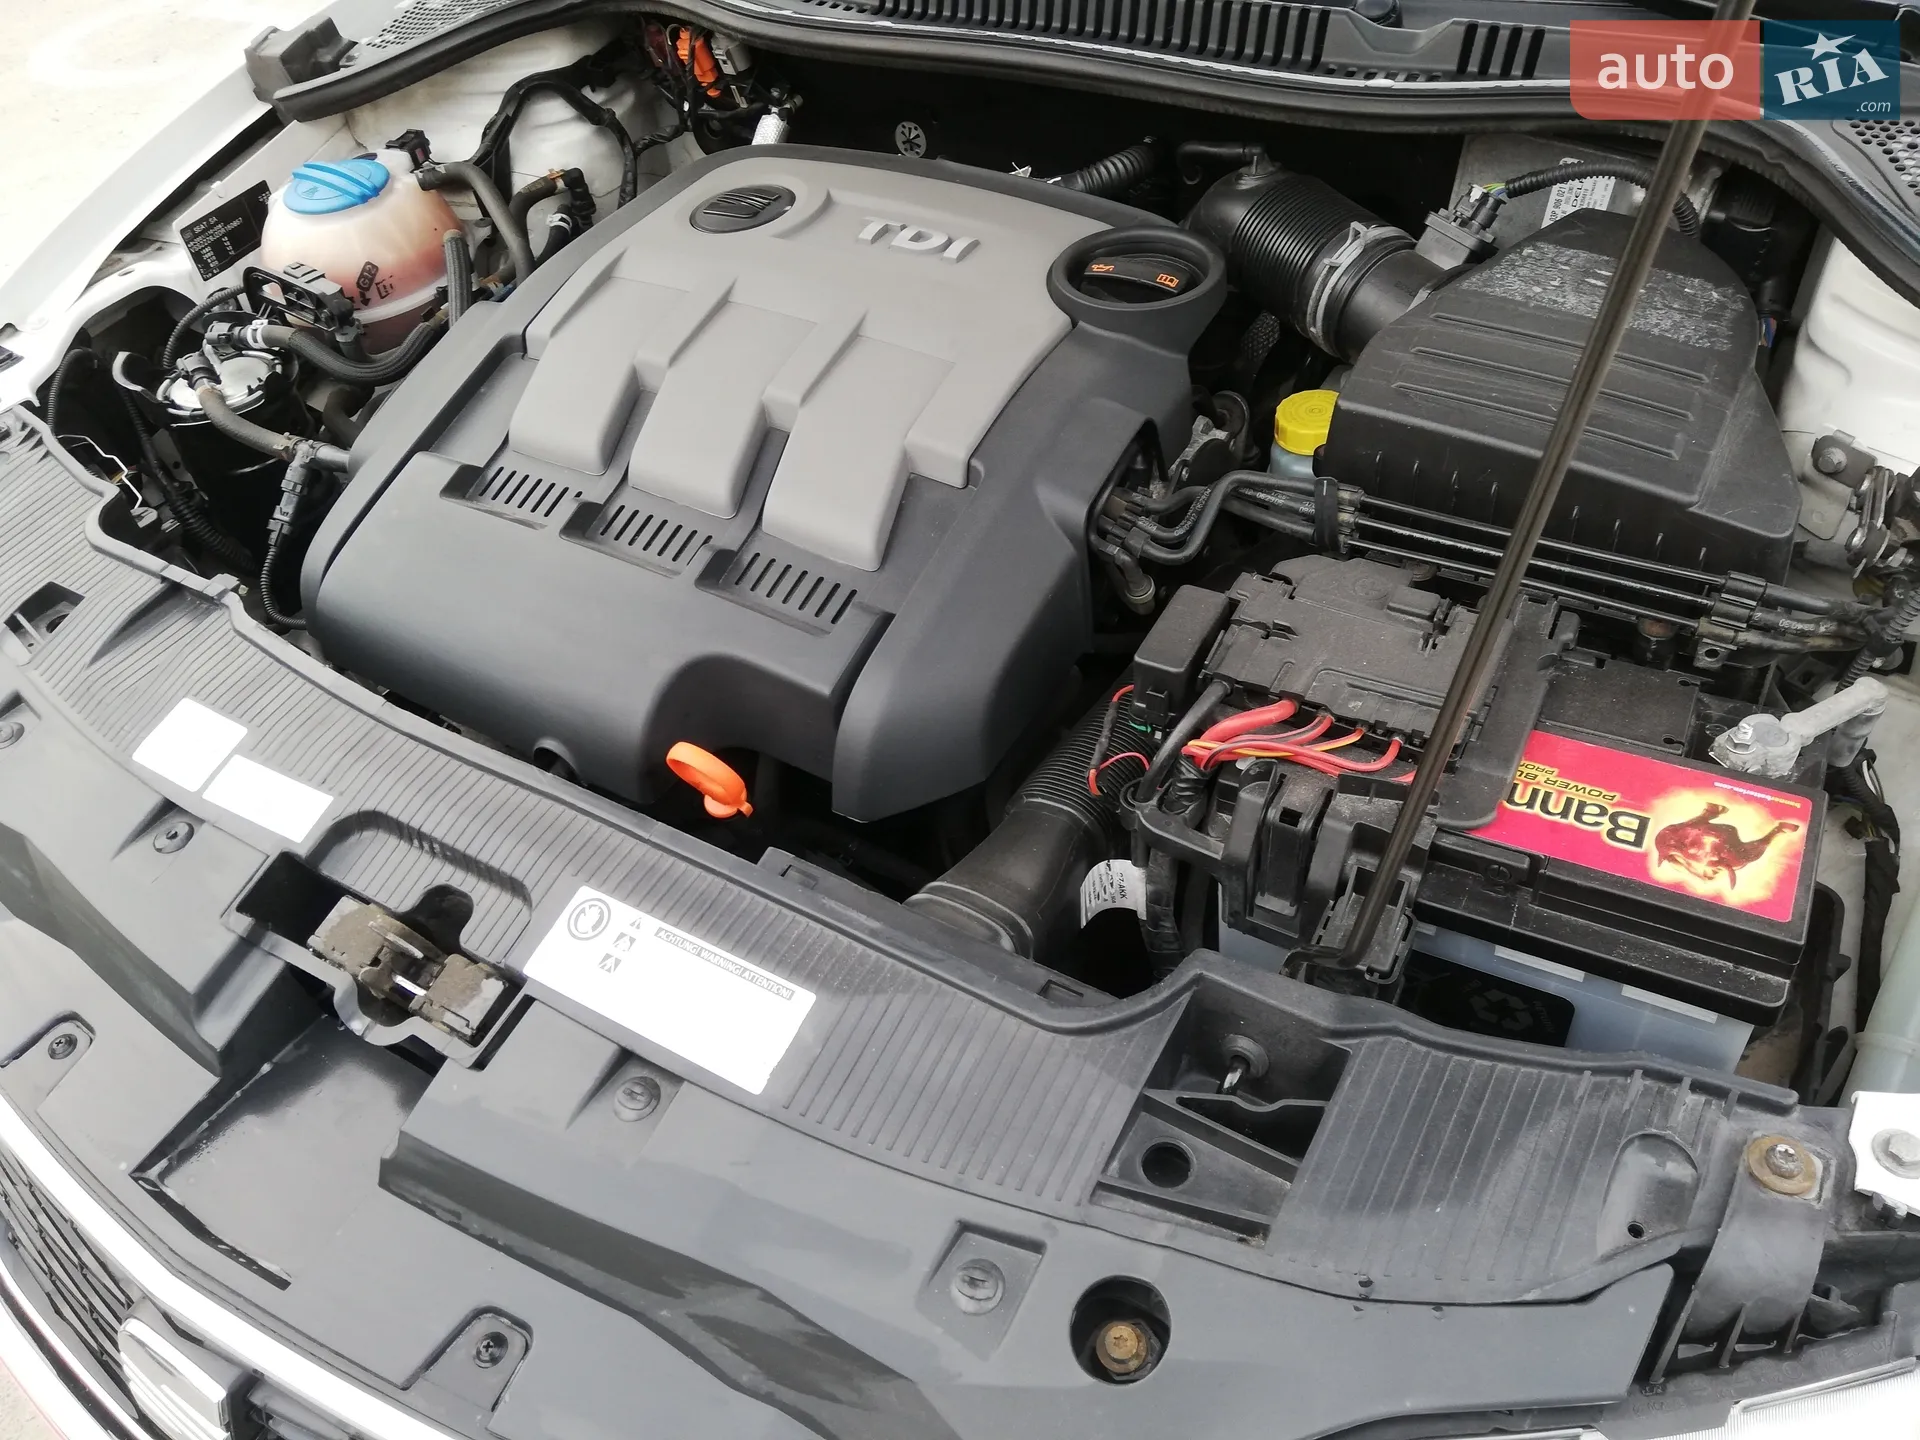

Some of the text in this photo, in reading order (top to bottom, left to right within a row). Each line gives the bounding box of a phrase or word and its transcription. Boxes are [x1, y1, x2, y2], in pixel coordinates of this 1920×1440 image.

[858, 216, 981, 263] TDI
[360, 265, 376, 287] G12
[1544, 778, 1617, 801] POWER
[657, 929, 792, 999] ACHTUNG! WARNING! ATTENTION!
